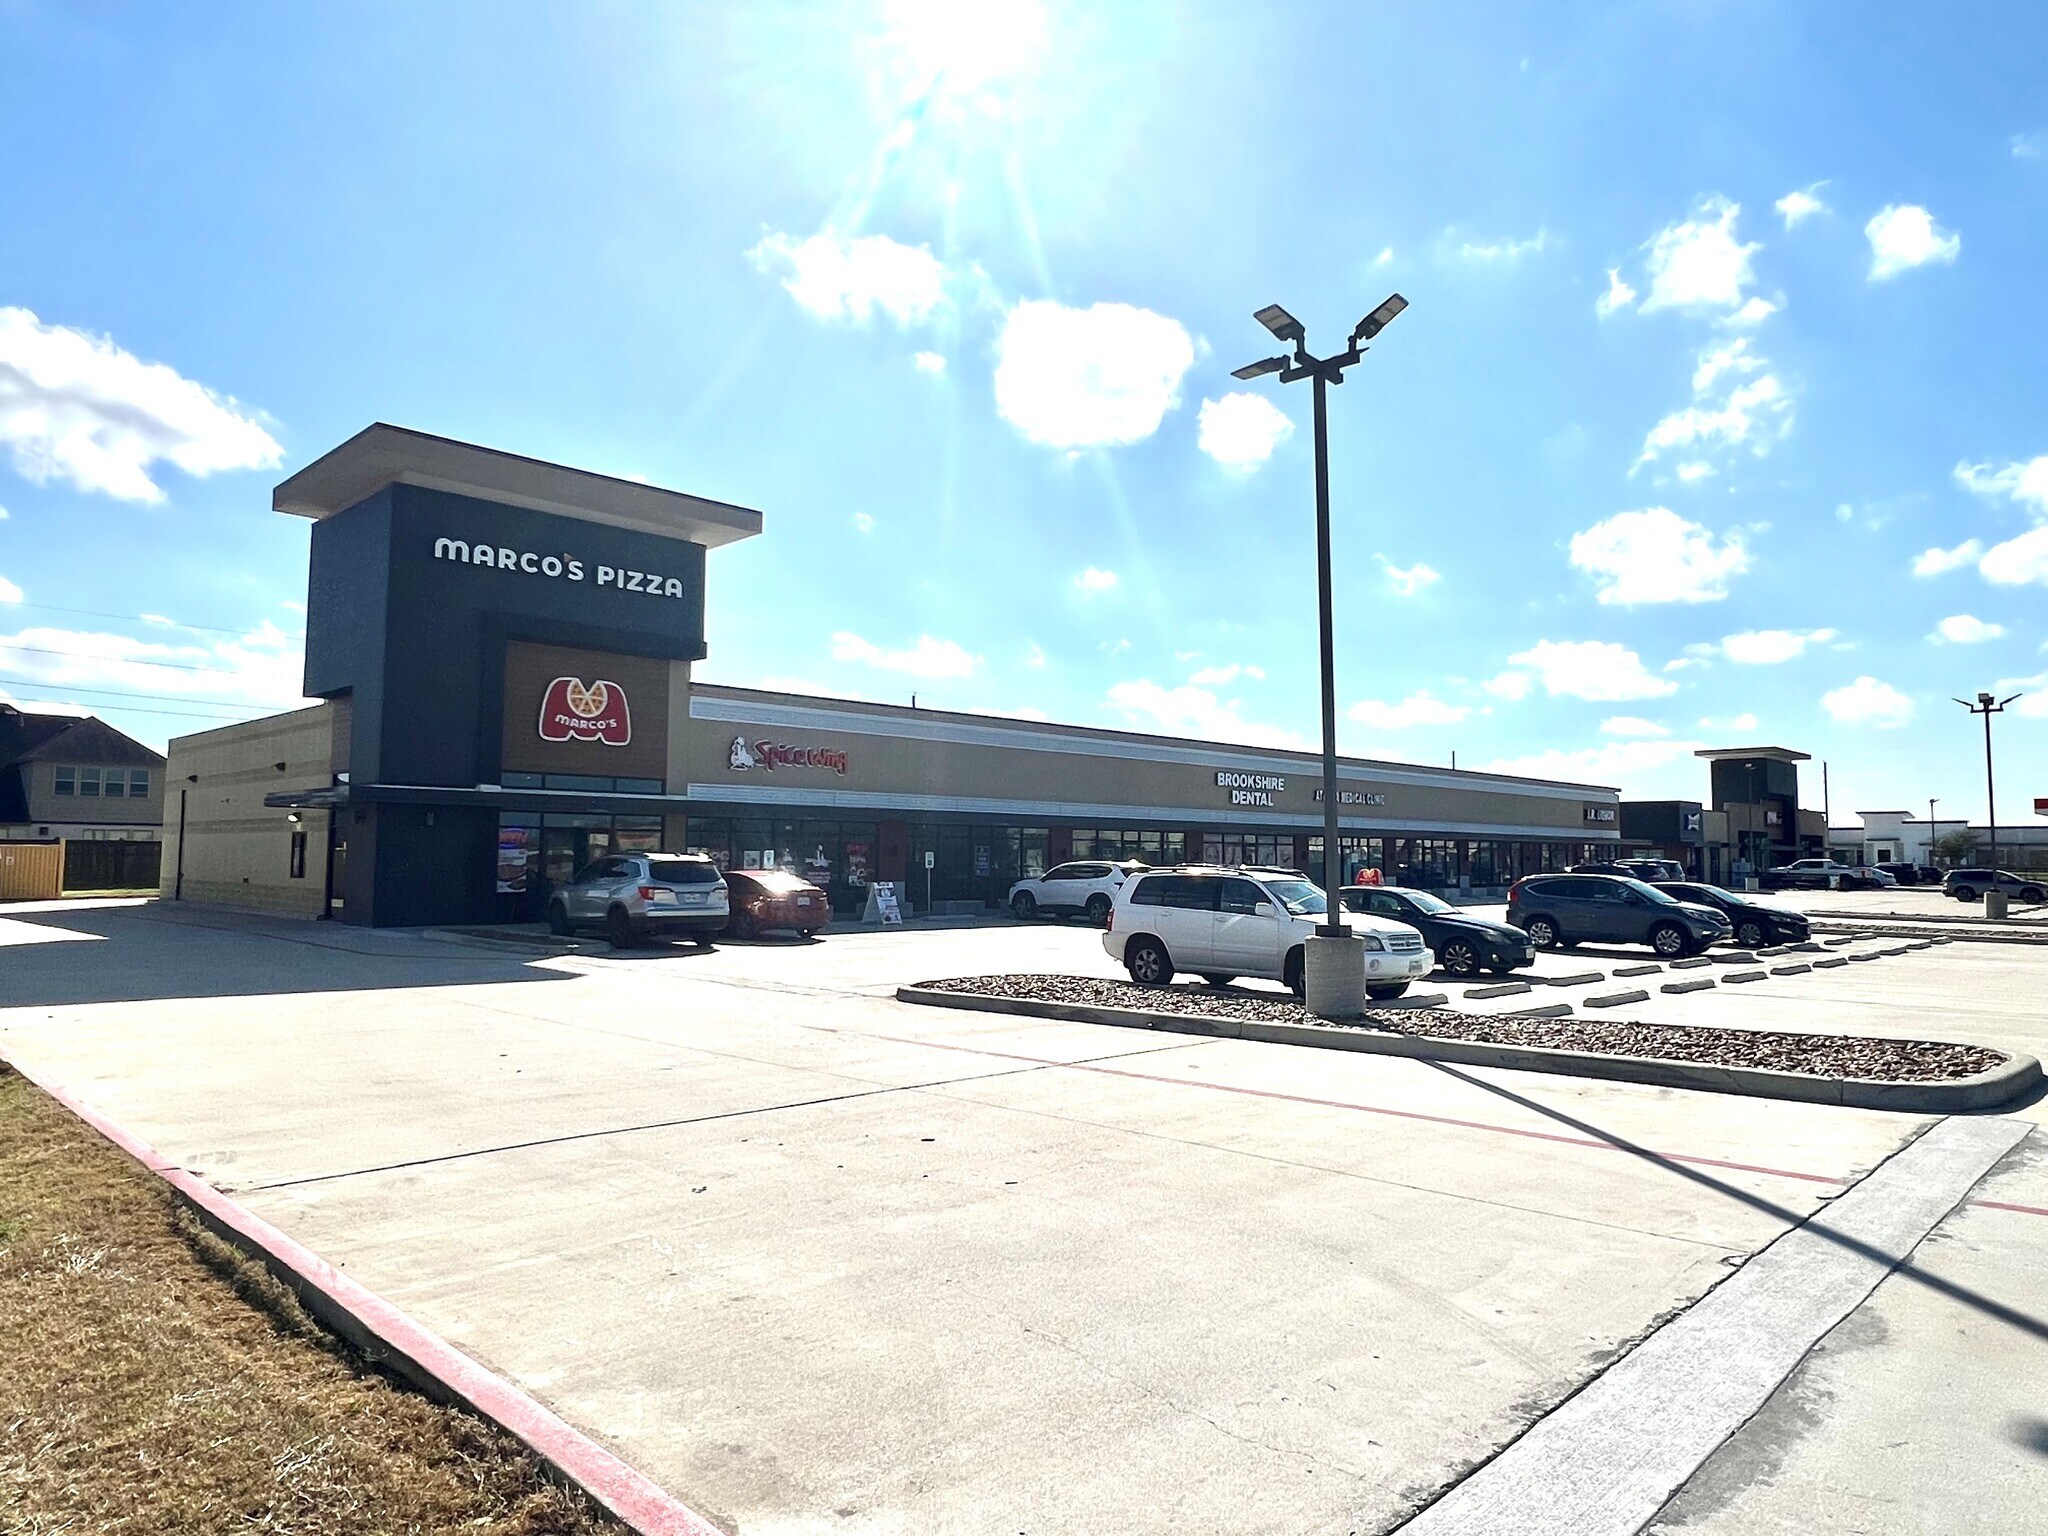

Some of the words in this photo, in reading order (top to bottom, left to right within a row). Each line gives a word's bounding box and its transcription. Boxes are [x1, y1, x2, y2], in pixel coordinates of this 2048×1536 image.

[434, 537, 585, 581] MARCO'S
[597, 565, 684, 598] PIZZA
[555, 714, 617, 729] MARCO'S
[1217, 772, 1285, 790] BROOKSHIRE
[1232, 790, 1274, 807] DENTAL
